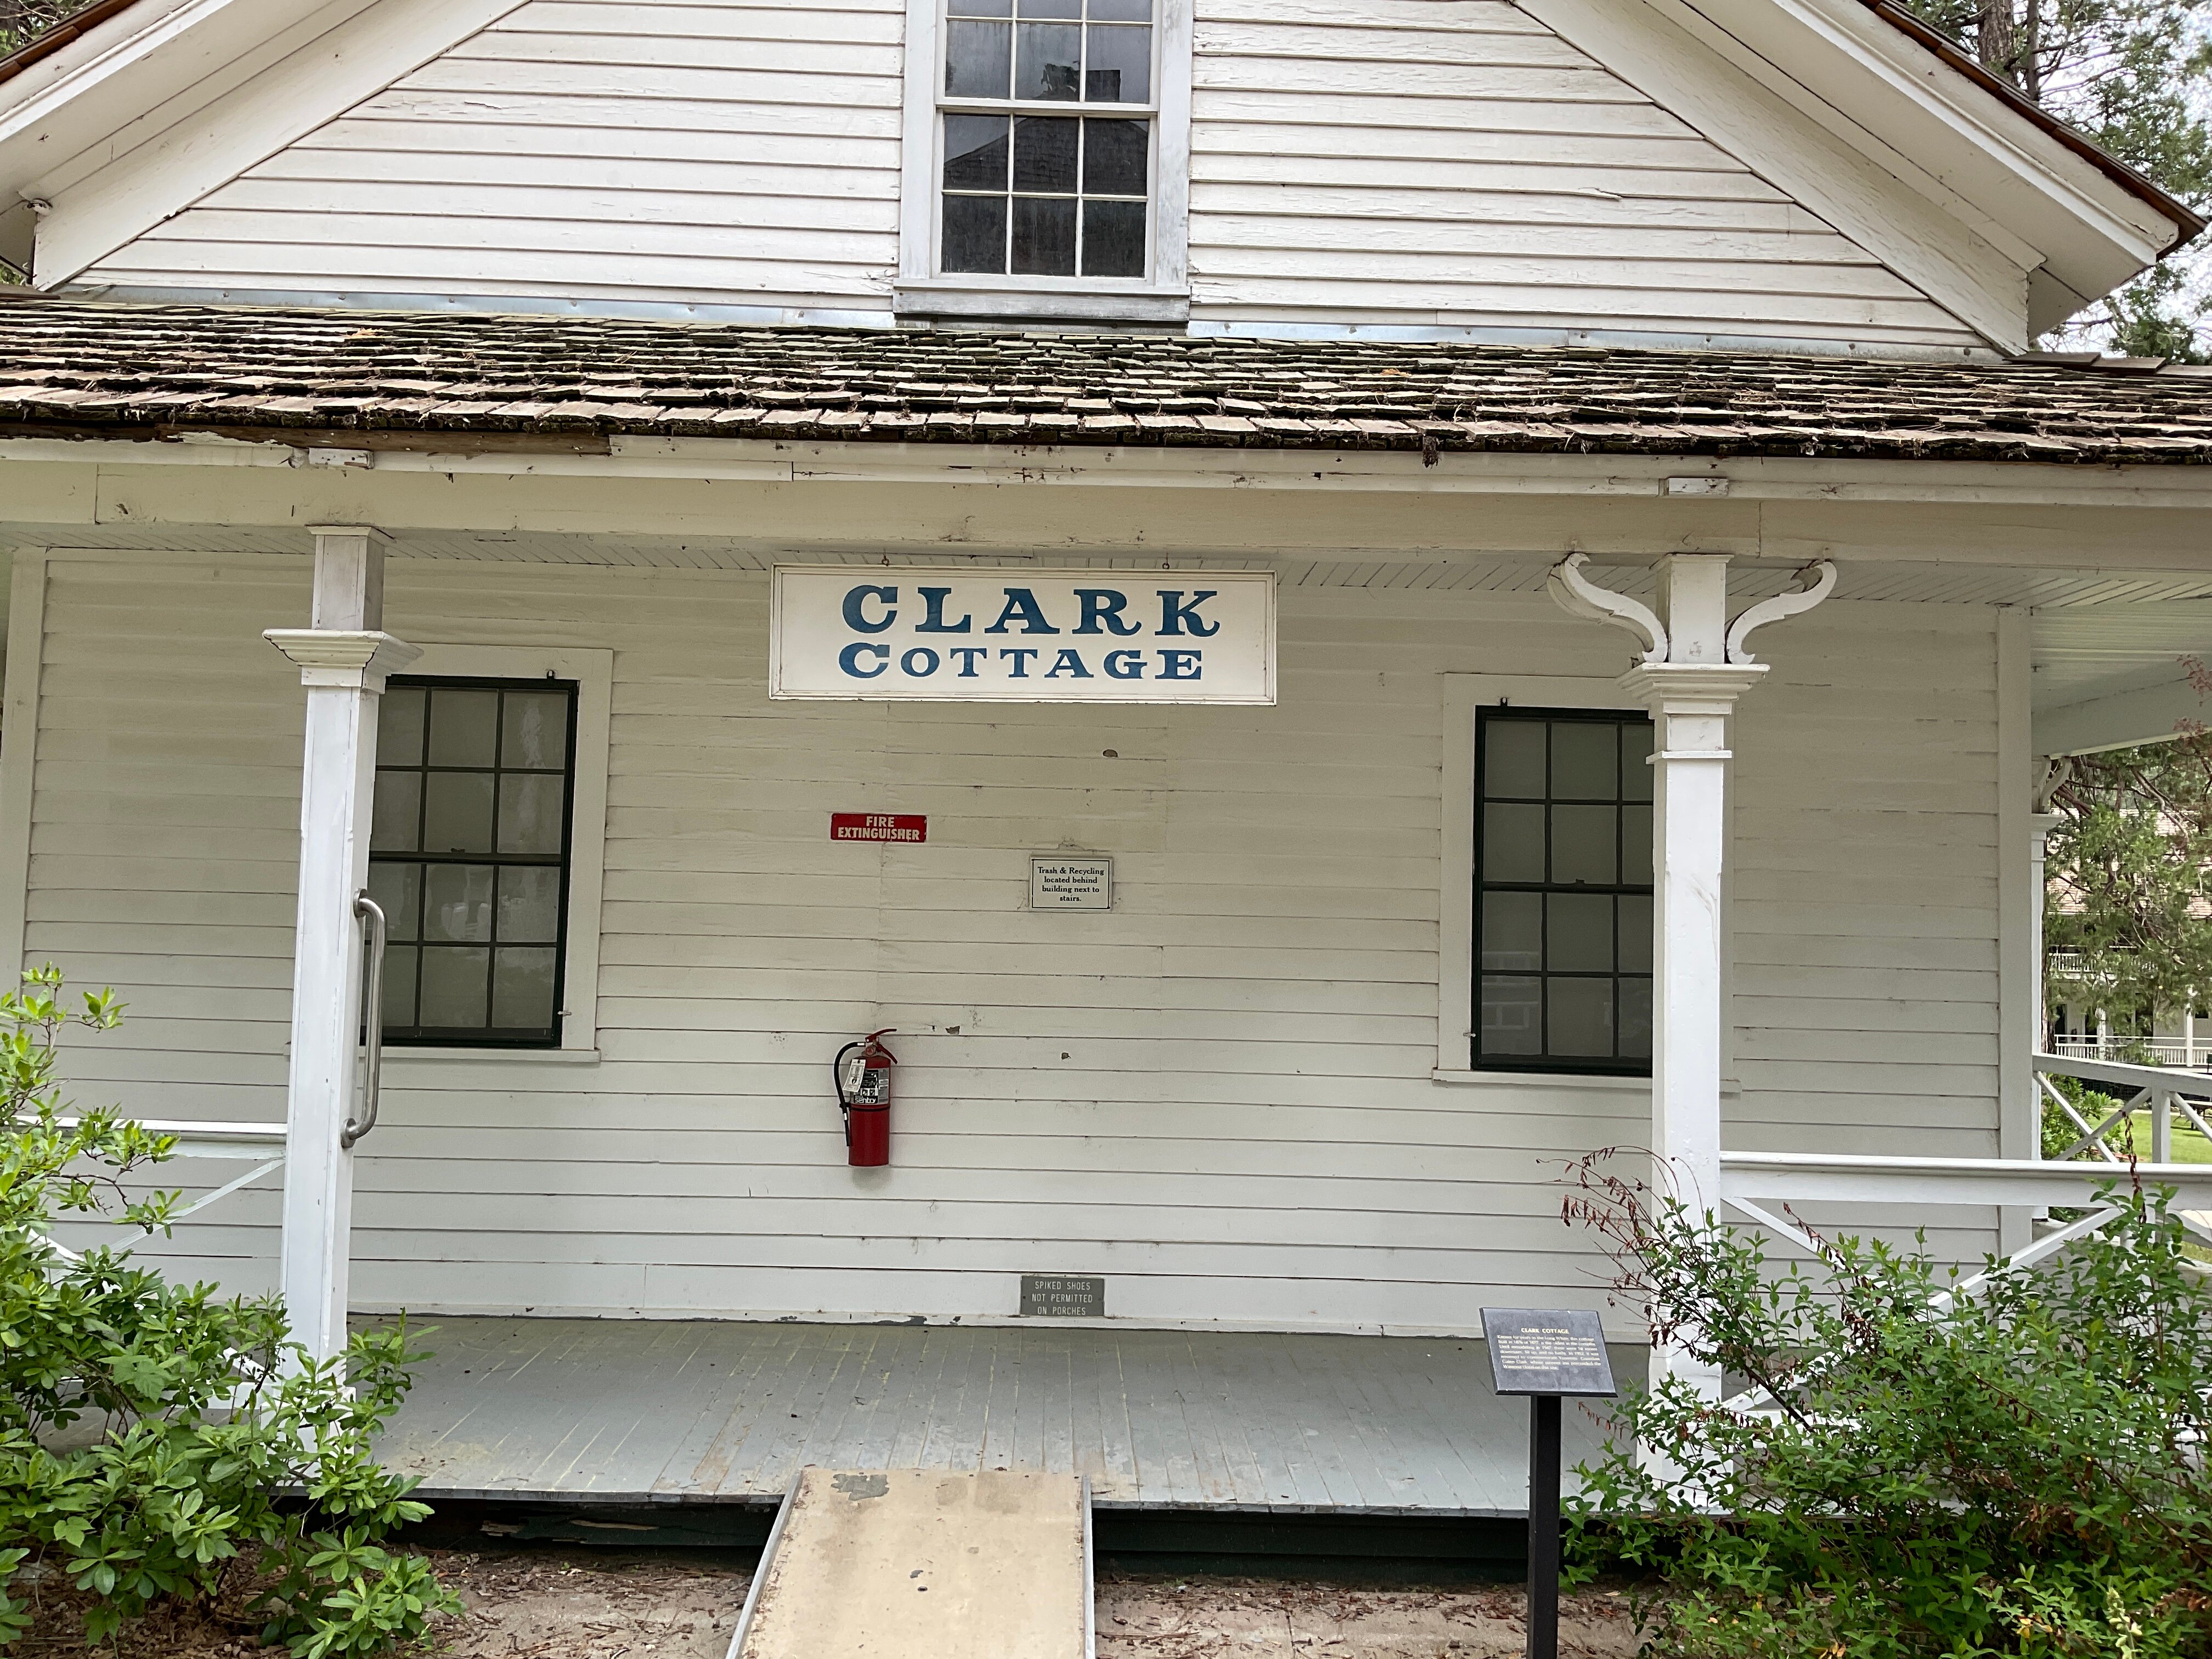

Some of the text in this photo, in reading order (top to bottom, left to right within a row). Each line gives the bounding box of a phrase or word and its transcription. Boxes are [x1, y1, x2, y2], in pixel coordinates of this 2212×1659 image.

[842, 585, 1221, 637] CLARK
[839, 642, 1202, 680] COTTAGE
[866, 816, 895, 827] FIRE
[838, 827, 920, 840] EXTINGUISHER
[1069, 867, 1104, 876] Recycling
[1042, 885, 1072, 893] building
[1035, 1281, 1091, 1290] SPIKED SHOES
[1032, 1293, 1093, 1303] NOT PERMITTED
[1037, 1306, 1086, 1316] ON PORCHES
